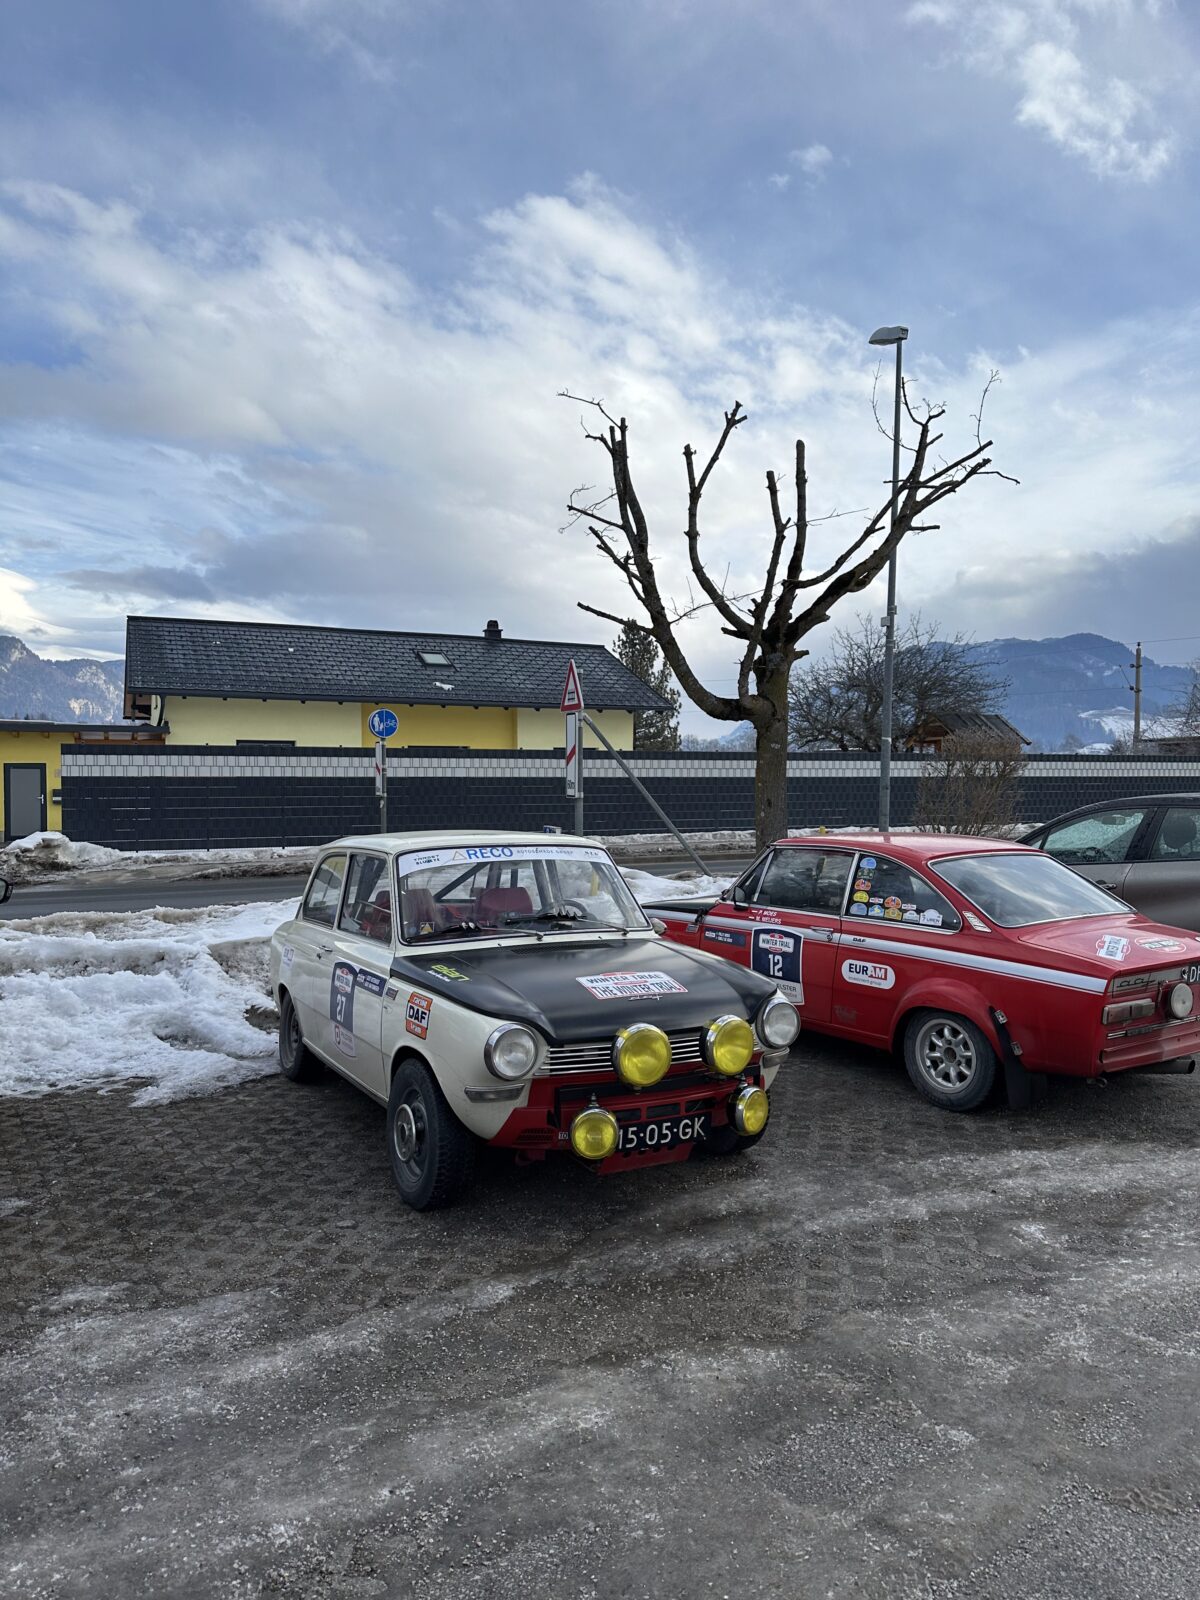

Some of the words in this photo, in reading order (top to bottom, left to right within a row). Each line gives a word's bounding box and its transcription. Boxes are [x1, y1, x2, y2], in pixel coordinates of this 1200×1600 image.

[465, 847, 514, 860] RECO
[761, 937, 778, 947] WINTER
[778, 939, 791, 949] TRIAL
[768, 953, 783, 977] 12
[586, 975, 629, 984] WINTER
[591, 985, 618, 997] THE
[615, 983, 652, 995] WINTER
[649, 980, 680, 994] TRIAL
[336, 993, 347, 1023] 27
[407, 1004, 428, 1024] DAF
